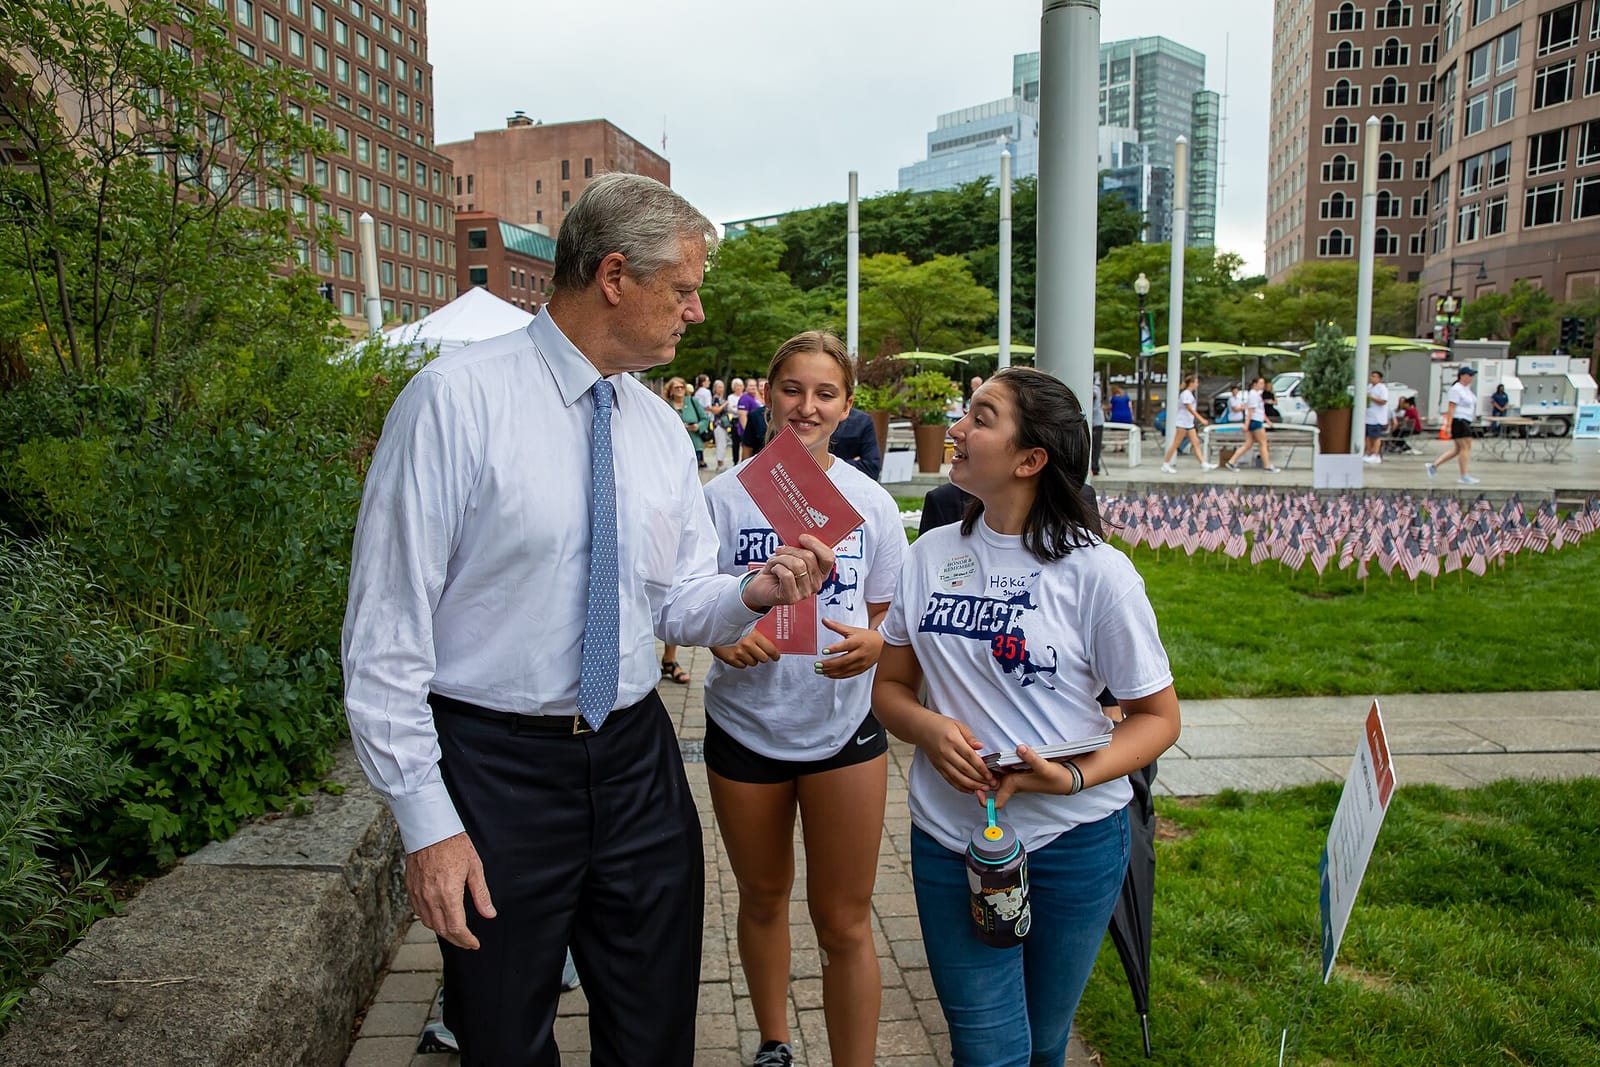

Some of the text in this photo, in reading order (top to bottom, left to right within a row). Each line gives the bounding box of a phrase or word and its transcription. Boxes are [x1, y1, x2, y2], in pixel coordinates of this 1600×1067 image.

[769, 468, 789, 494] MILITARY
[801, 512, 815, 529] FUND
[775, 462, 809, 507] MASSACHUSETTS
[943, 562, 974, 573] REMEMBER
[921, 597, 1025, 635] PROJECT
[992, 635, 1027, 661] 351
